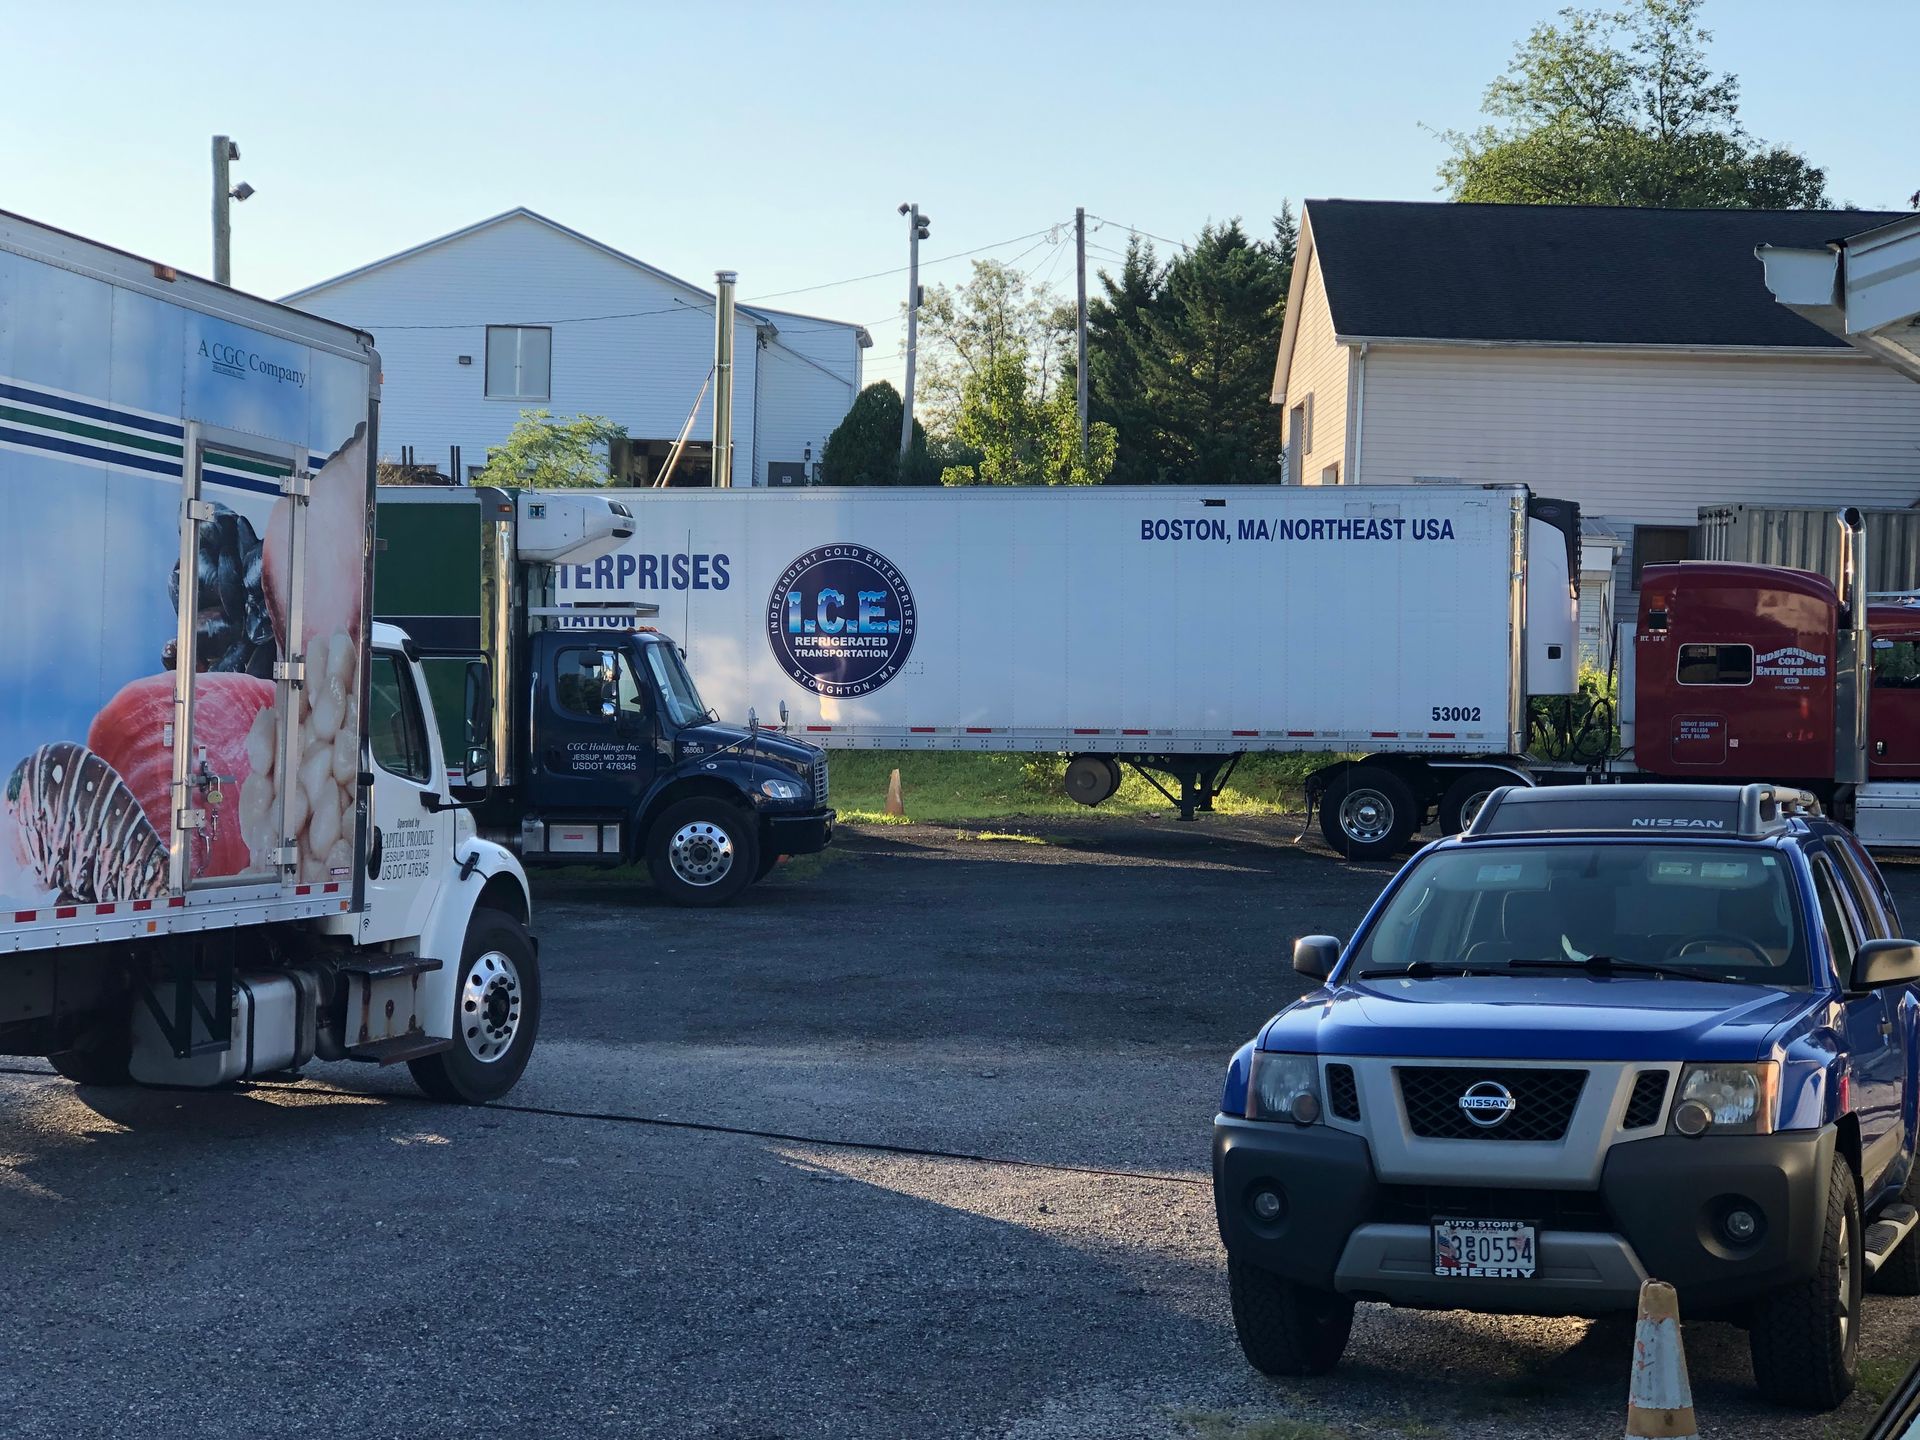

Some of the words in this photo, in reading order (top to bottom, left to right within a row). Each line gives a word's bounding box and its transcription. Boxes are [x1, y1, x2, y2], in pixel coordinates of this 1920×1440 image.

[197, 339, 209, 357] A
[212, 342, 245, 367] CGC
[249, 353, 306, 388] Company
[1141, 519, 1231, 544] BOSTON,
[1412, 519, 1455, 540] USA
[769, 553, 817, 634] INDEPENDENT
[824, 547, 859, 557] COLD
[865, 553, 913, 635] ENTERPRISES
[787, 587, 900, 634] I.C.E.
[794, 636, 888, 647] REFRIGERATED
[794, 649, 889, 658] TRANSPORTATION
[1778, 657, 1805, 666] COLD
[879, 664, 896, 681] MA
[1431, 706, 1481, 722] 53002
[567, 742, 588, 751] CGC
[588, 742, 625, 753] Holdings
[626, 742, 641, 751] Inc.
[572, 762, 604, 771] USDOT
[605, 762, 637, 771] 476345
[1632, 818, 1724, 828] NISSAN
[406, 829, 434, 847] PRODUCE
[382, 864, 392, 880] US
[392, 863, 407, 880] DOT
[1463, 1099, 1509, 1107] NISSAN
[1443, 1220, 1475, 1228] AUTO
[1435, 1266, 1535, 1278] SHEEHY
